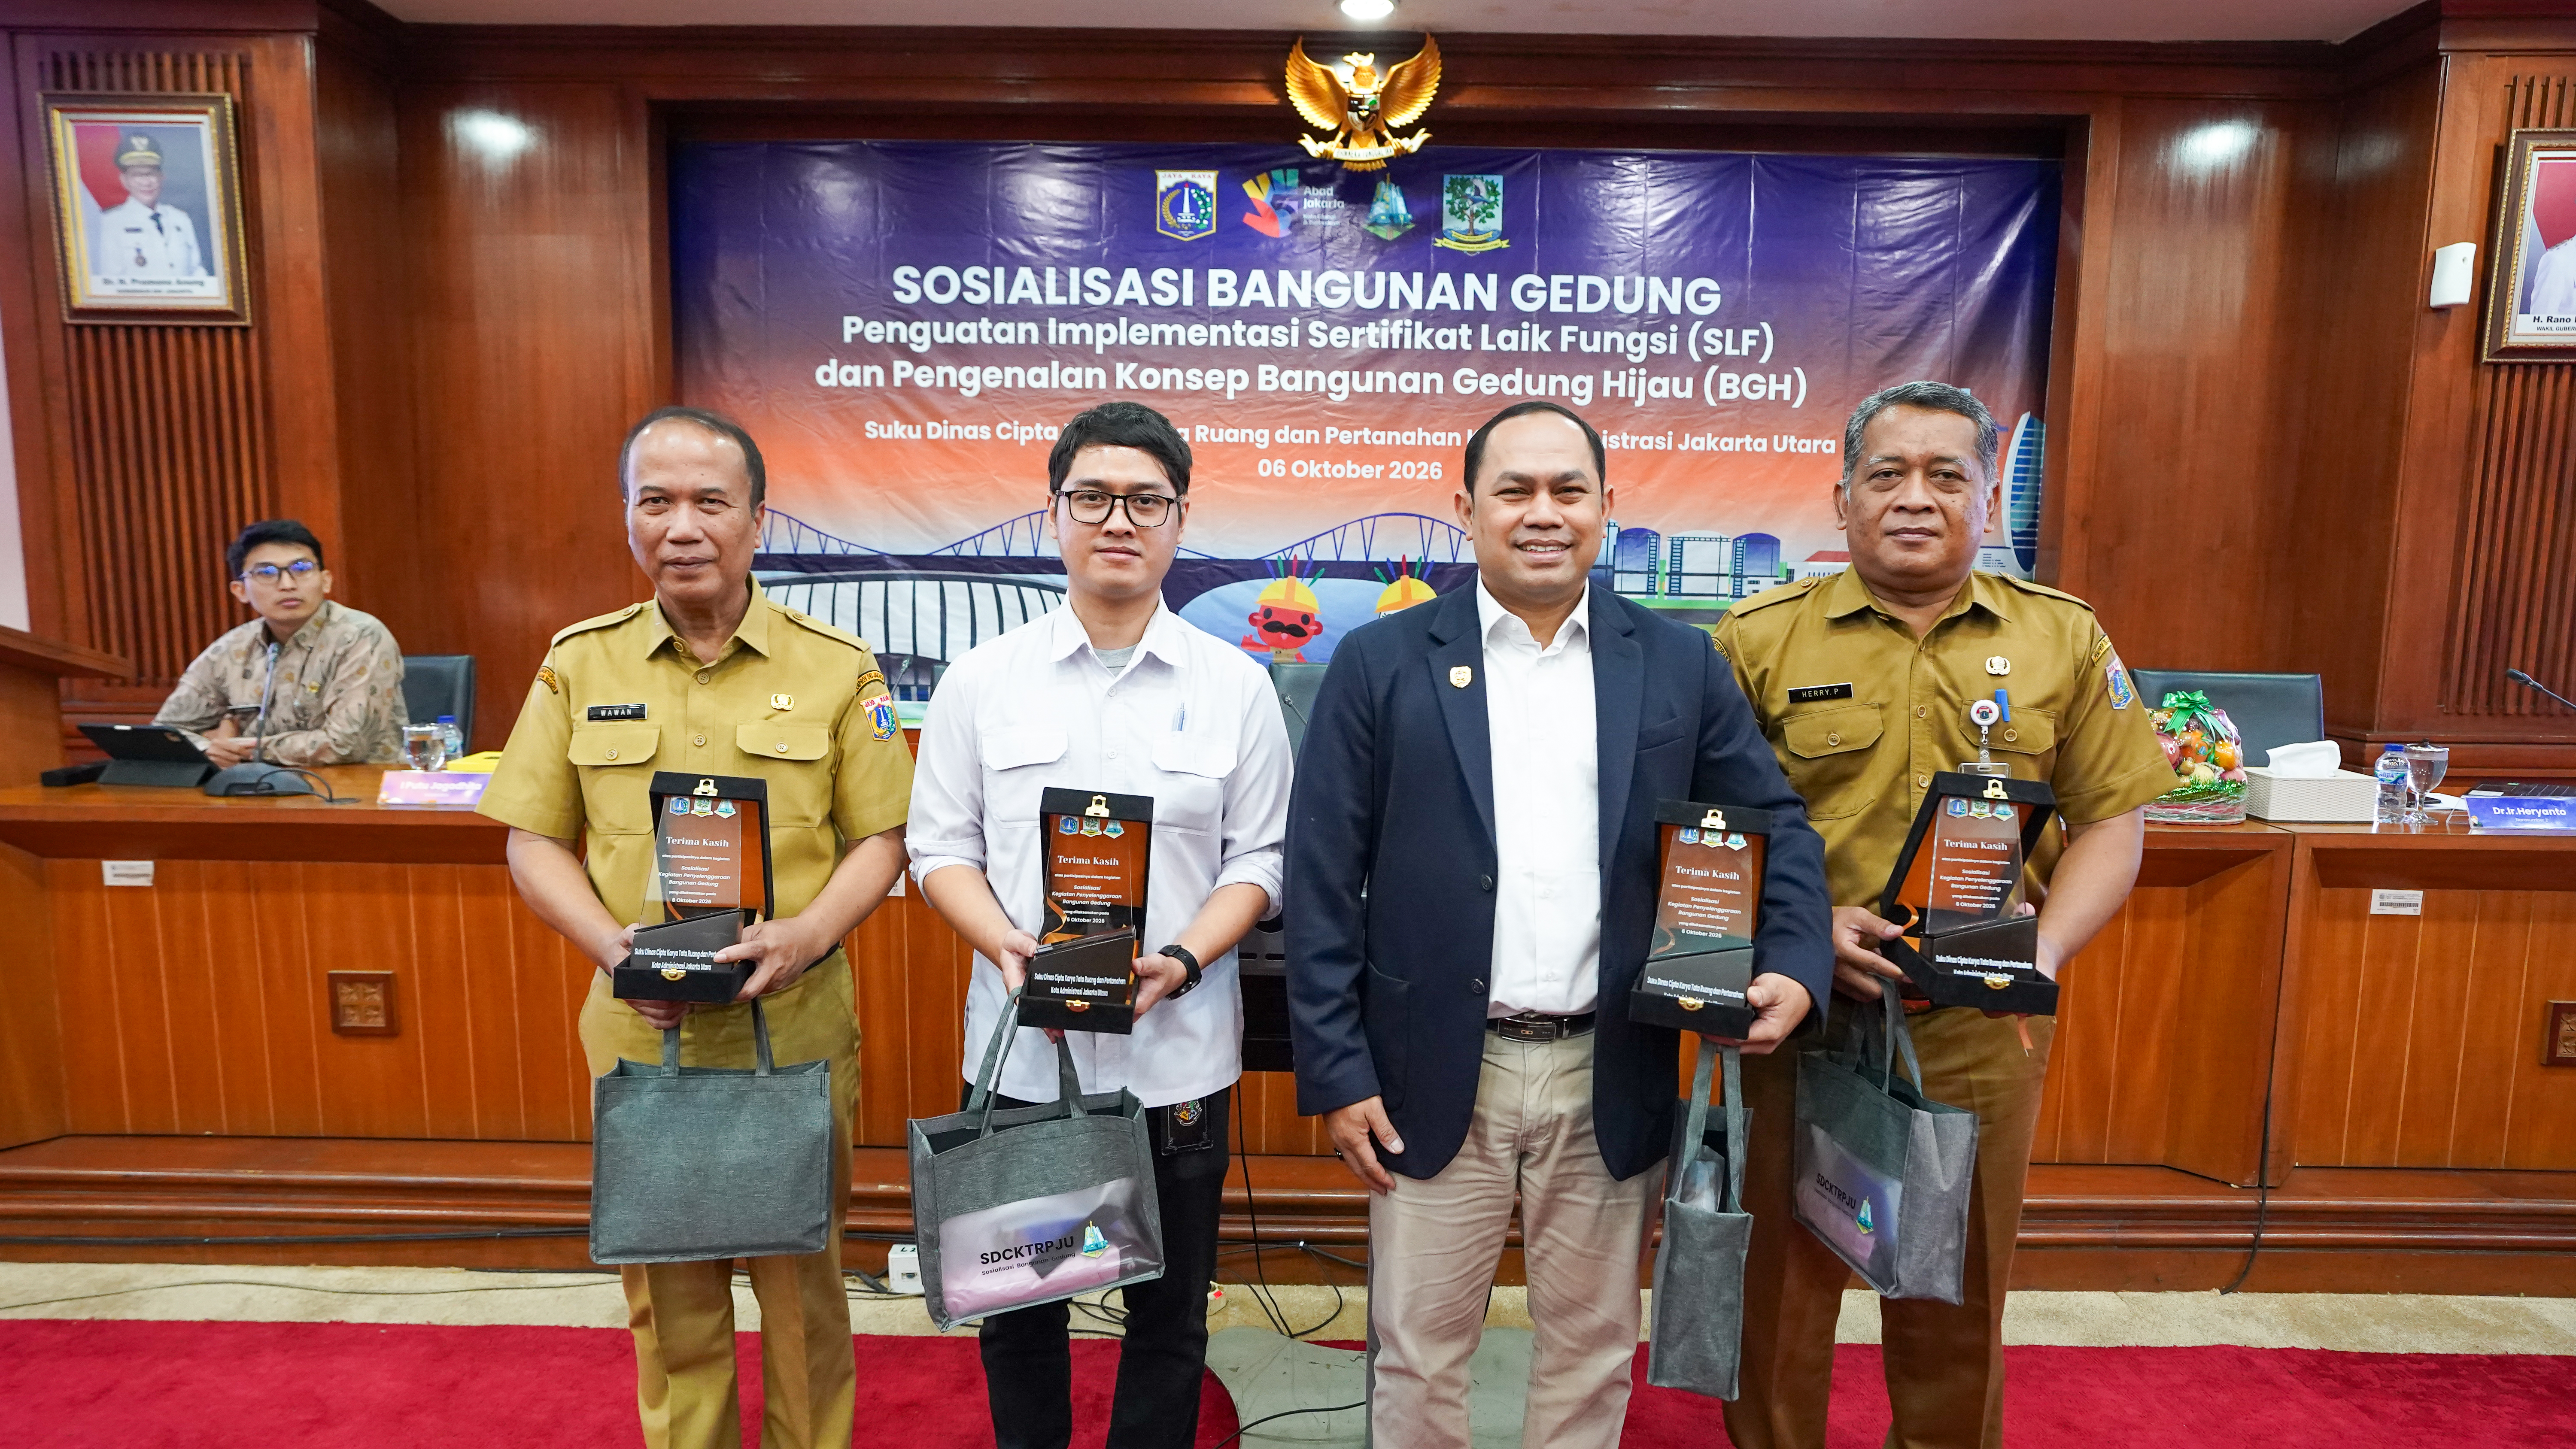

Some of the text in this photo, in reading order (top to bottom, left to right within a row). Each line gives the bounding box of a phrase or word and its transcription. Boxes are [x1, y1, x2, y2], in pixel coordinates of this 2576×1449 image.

[1303, 185, 1334, 196] Abad
[1303, 198, 1345, 210] Jakarta
[893, 266, 1720, 315] SOSIALISASI BANGUNAN GEDUNG
[843, 315, 1774, 364] Penguatan Implementasi Sertifikat Laik Fungsi (SLF)
[815, 359, 1807, 408] dan Pengenalan Konsep Bangunan Gedung Hijau (BGH)
[865, 419, 1058, 446] Suku Dinas Cipta
[1196, 424, 1269, 449] Ruang
[1275, 425, 1319, 445] dan
[1325, 426, 1461, 447] Pertanahan
[1678, 432, 1768, 453] Jakarta
[1774, 435, 1836, 454] Utara
[1258, 459, 1443, 480] 06 Oktober 2026
[1802, 689, 1832, 697] HERRY.
[2492, 807, 2567, 817] Dr.Ir.Heryanto
[666, 837, 729, 847] Terima Kasih
[1944, 839, 2007, 850] Terima Kasih
[1057, 855, 1119, 865] Terima Kasih
[1675, 866, 1739, 880] Terima Kasih
[1693, 904, 1741, 914] Penyelenggaraan
[656, 948, 666, 958] Cipta
[667, 949, 678, 958] Karya
[688, 950, 700, 959] Ruang
[1054, 973, 1064, 983] Cipta
[1065, 974, 1075, 984] Karya
[1084, 976, 1096, 985] Ruang
[1816, 1173, 1856, 1209] SDCKTRPJU
[980, 1236, 1074, 1264] SDCKTRPJU
[982, 1252, 1075, 1275] Sosialisasi Bangunan Gedung
